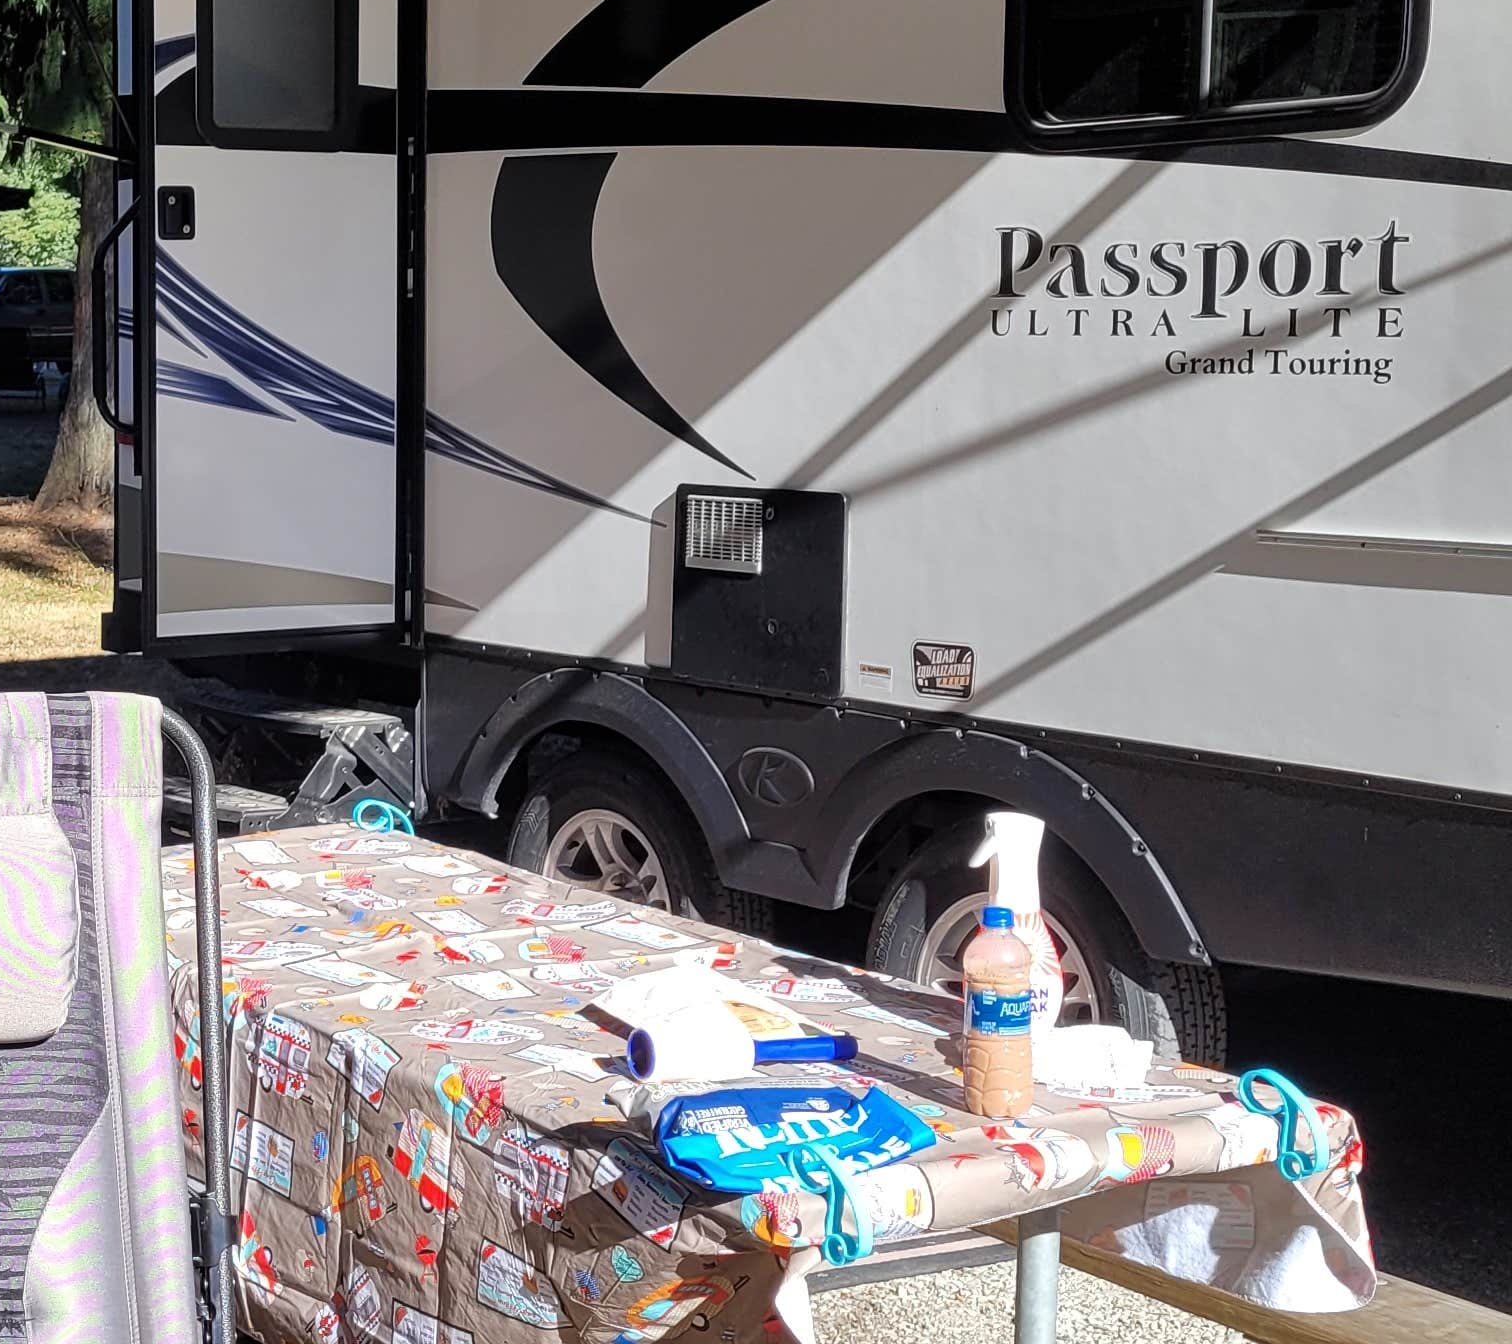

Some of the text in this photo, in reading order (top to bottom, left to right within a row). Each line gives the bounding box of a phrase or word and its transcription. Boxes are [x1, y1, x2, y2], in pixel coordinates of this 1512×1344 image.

[991, 219, 1414, 320] Passport
[990, 307, 1406, 339] ULTRA LITE
[1165, 349, 1394, 384] Grand Touring
